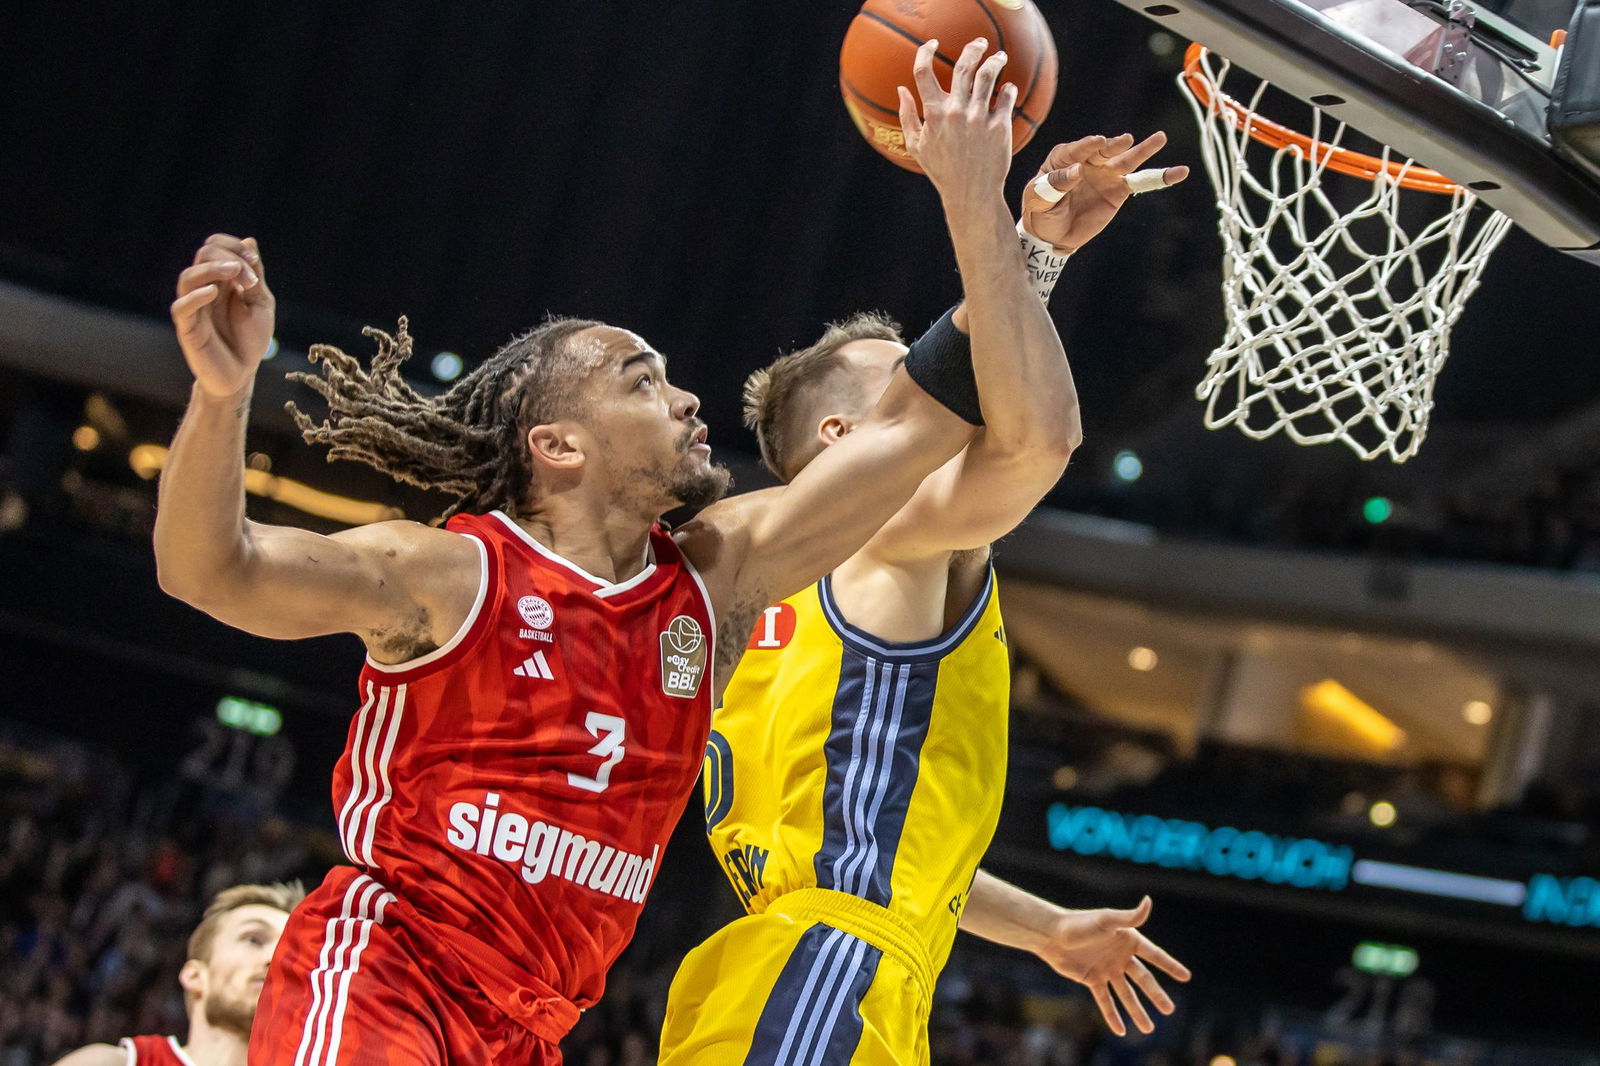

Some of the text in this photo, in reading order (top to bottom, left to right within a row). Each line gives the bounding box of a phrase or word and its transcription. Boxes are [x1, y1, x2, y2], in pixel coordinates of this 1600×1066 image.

[519, 629, 554, 643] BASKETBALL
[667, 671, 696, 691] BBL
[568, 711, 626, 793] 3
[447, 792, 660, 905] siegmund
